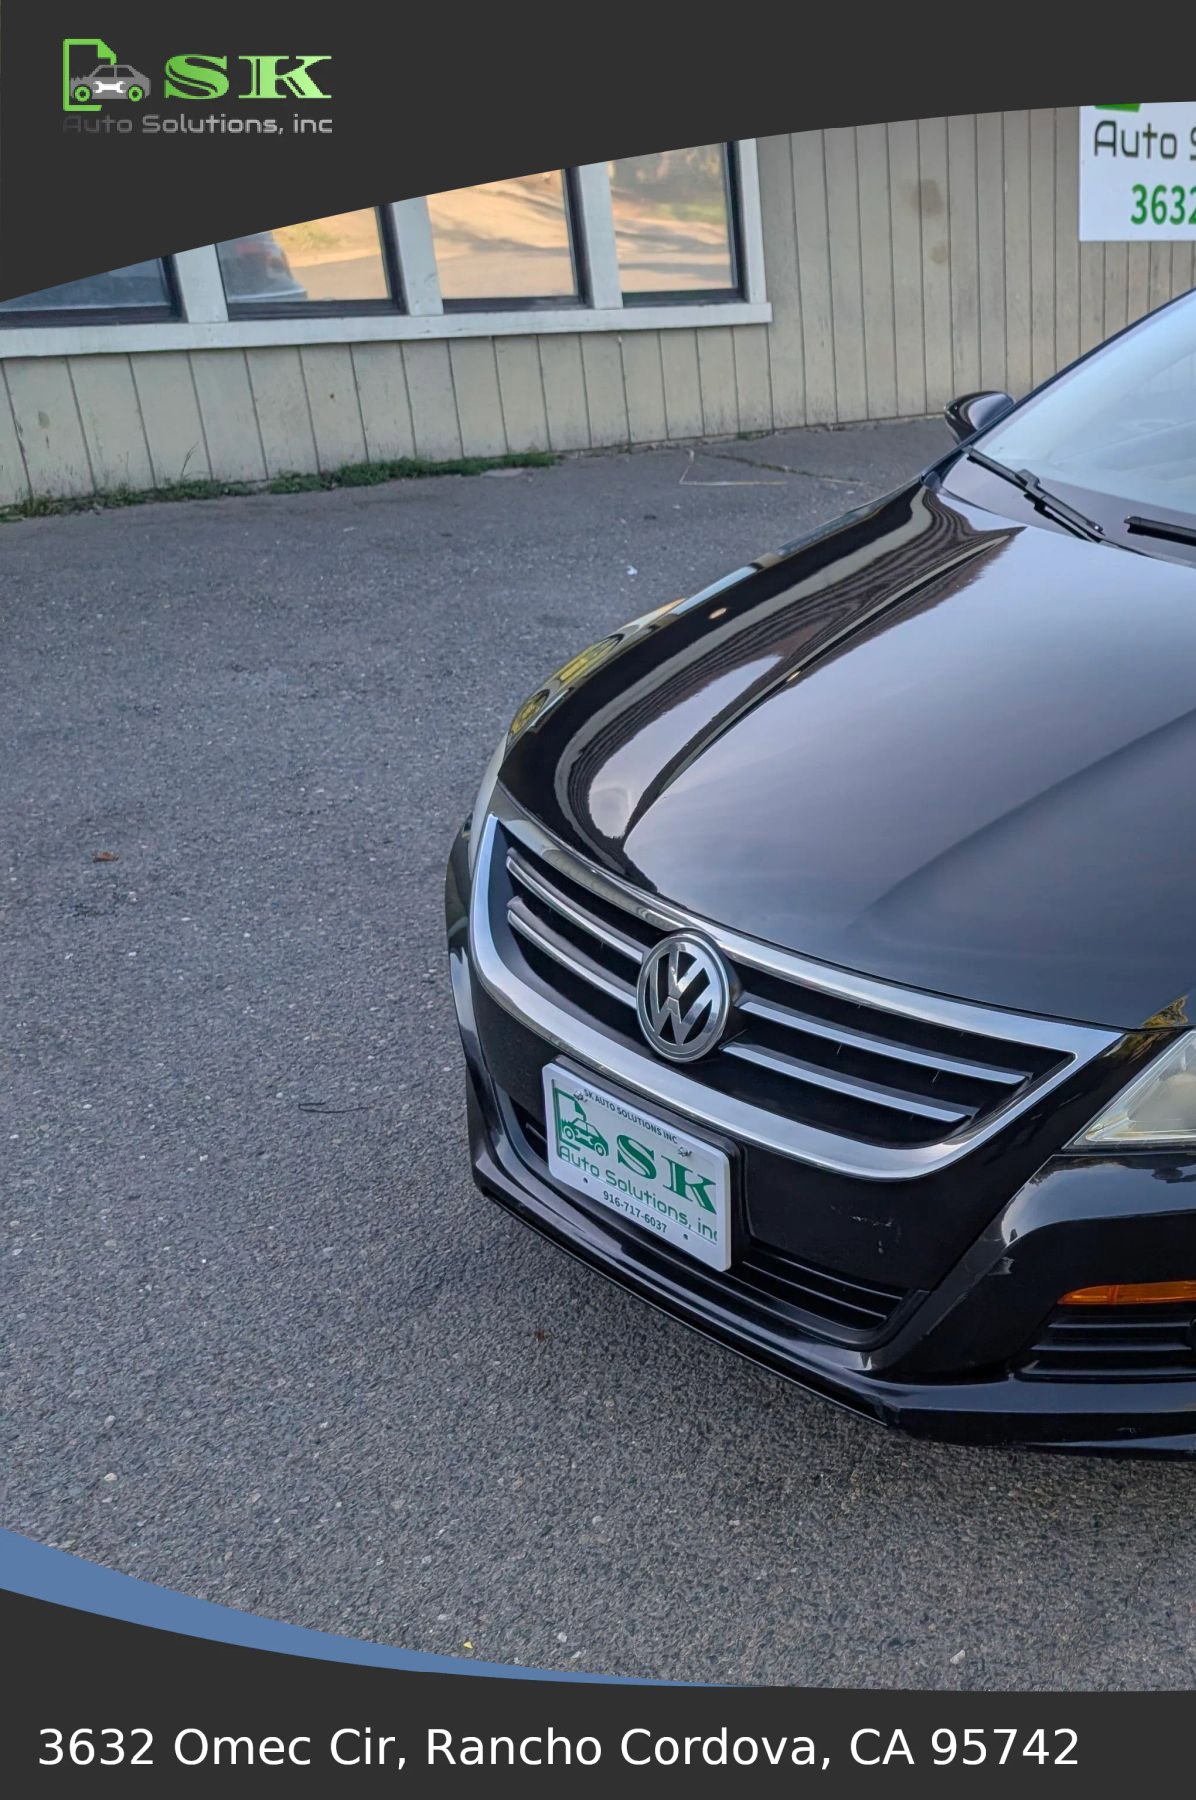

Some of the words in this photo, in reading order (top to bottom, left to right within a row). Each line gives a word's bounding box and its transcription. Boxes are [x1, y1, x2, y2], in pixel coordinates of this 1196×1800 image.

[1094, 119, 1177, 160] Auto
[583, 1088, 595, 1101] SK
[595, 1095, 616, 1112] AUTO
[616, 1106, 662, 1136] SOLUTIONS
[663, 1131, 678, 1145] INC
[559, 1145, 600, 1178] Auto
[605, 1169, 693, 1230] Solutions,
[616, 1134, 717, 1215] SK
[603, 1190, 667, 1233] 916-717-6037
